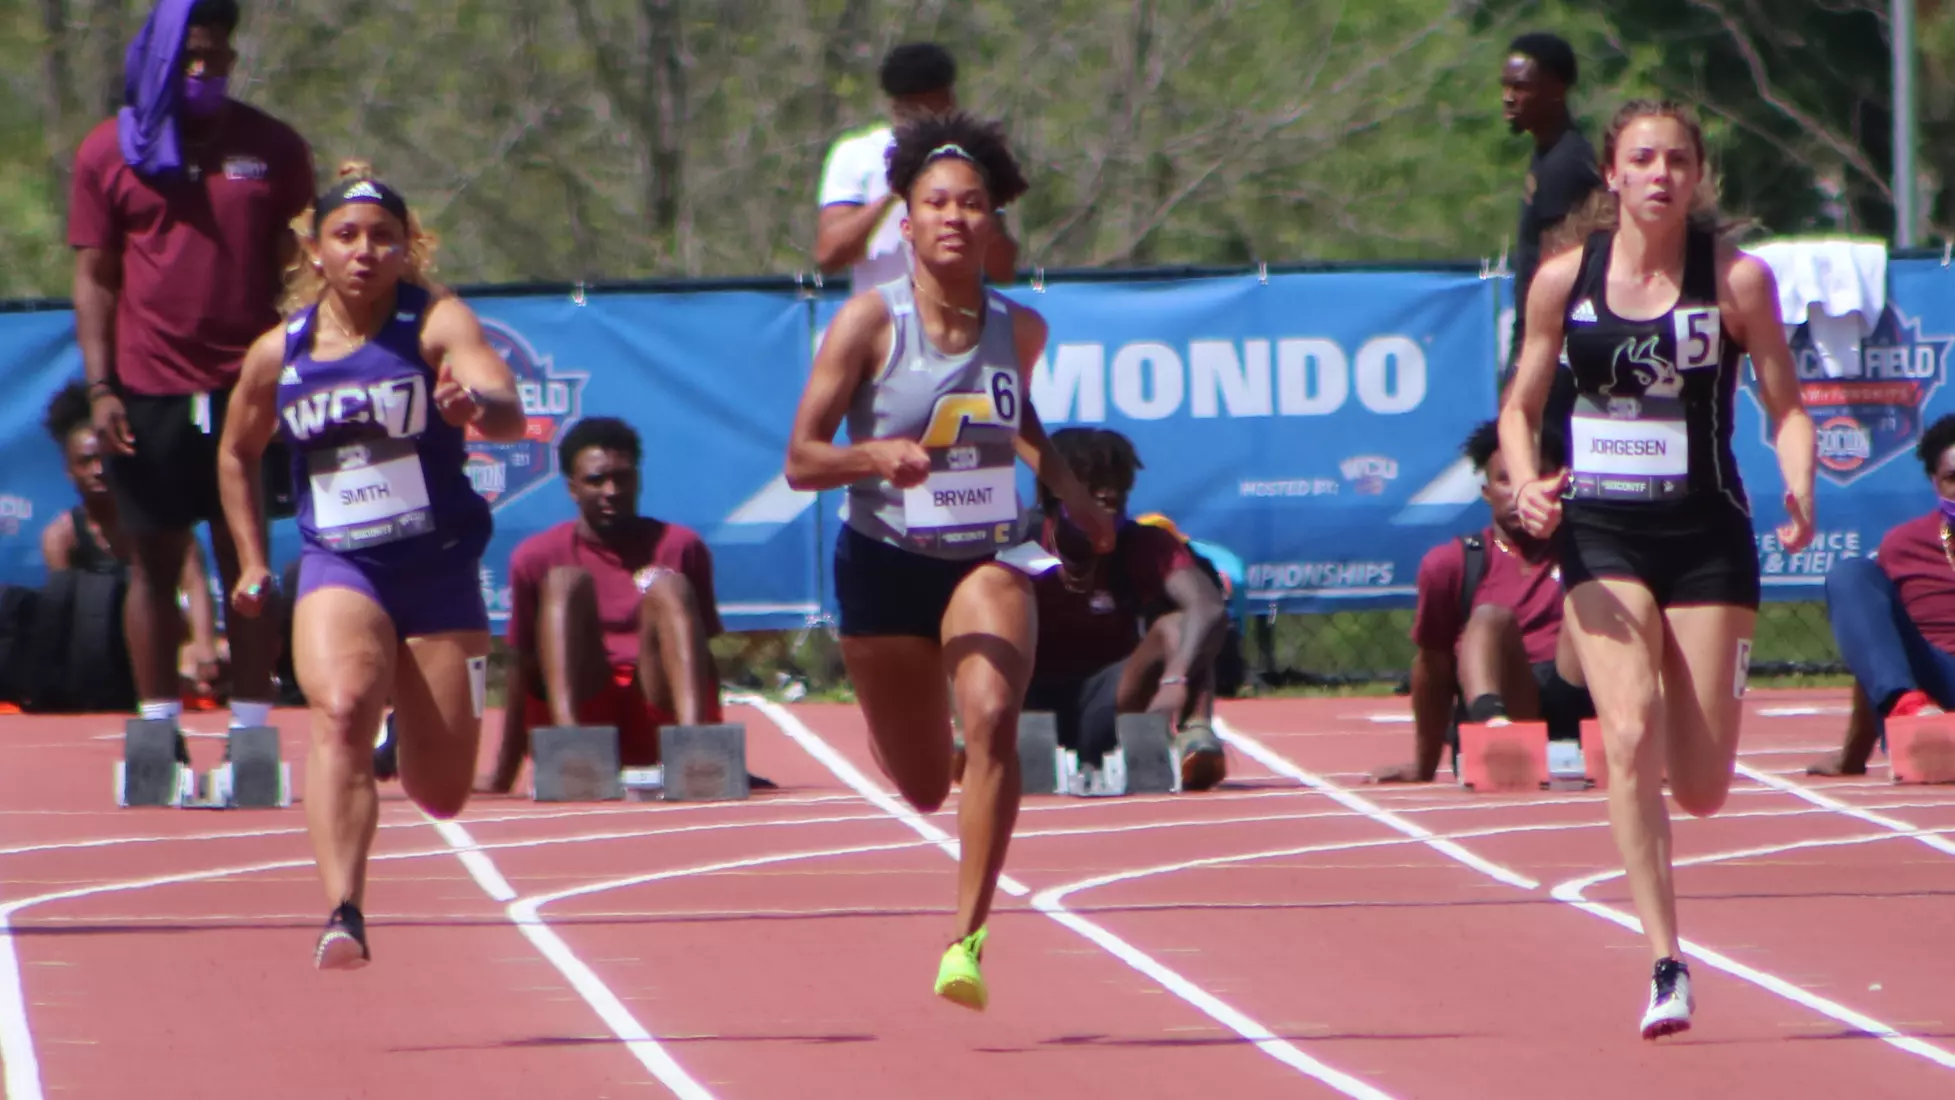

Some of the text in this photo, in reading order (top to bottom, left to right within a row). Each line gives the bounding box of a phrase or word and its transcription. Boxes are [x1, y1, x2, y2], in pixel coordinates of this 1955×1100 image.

[1688, 312, 1710, 366] 5
[1864, 346, 1936, 379] FIELD
[1030, 336, 1427, 423] MONDO
[391, 382, 415, 435] 7
[991, 372, 1016, 421] 6
[1590, 438, 1667, 457] JORGESEN
[1339, 456, 1399, 481] WCU
[339, 482, 391, 506] SMITH
[932, 487, 994, 507] BRYANT
